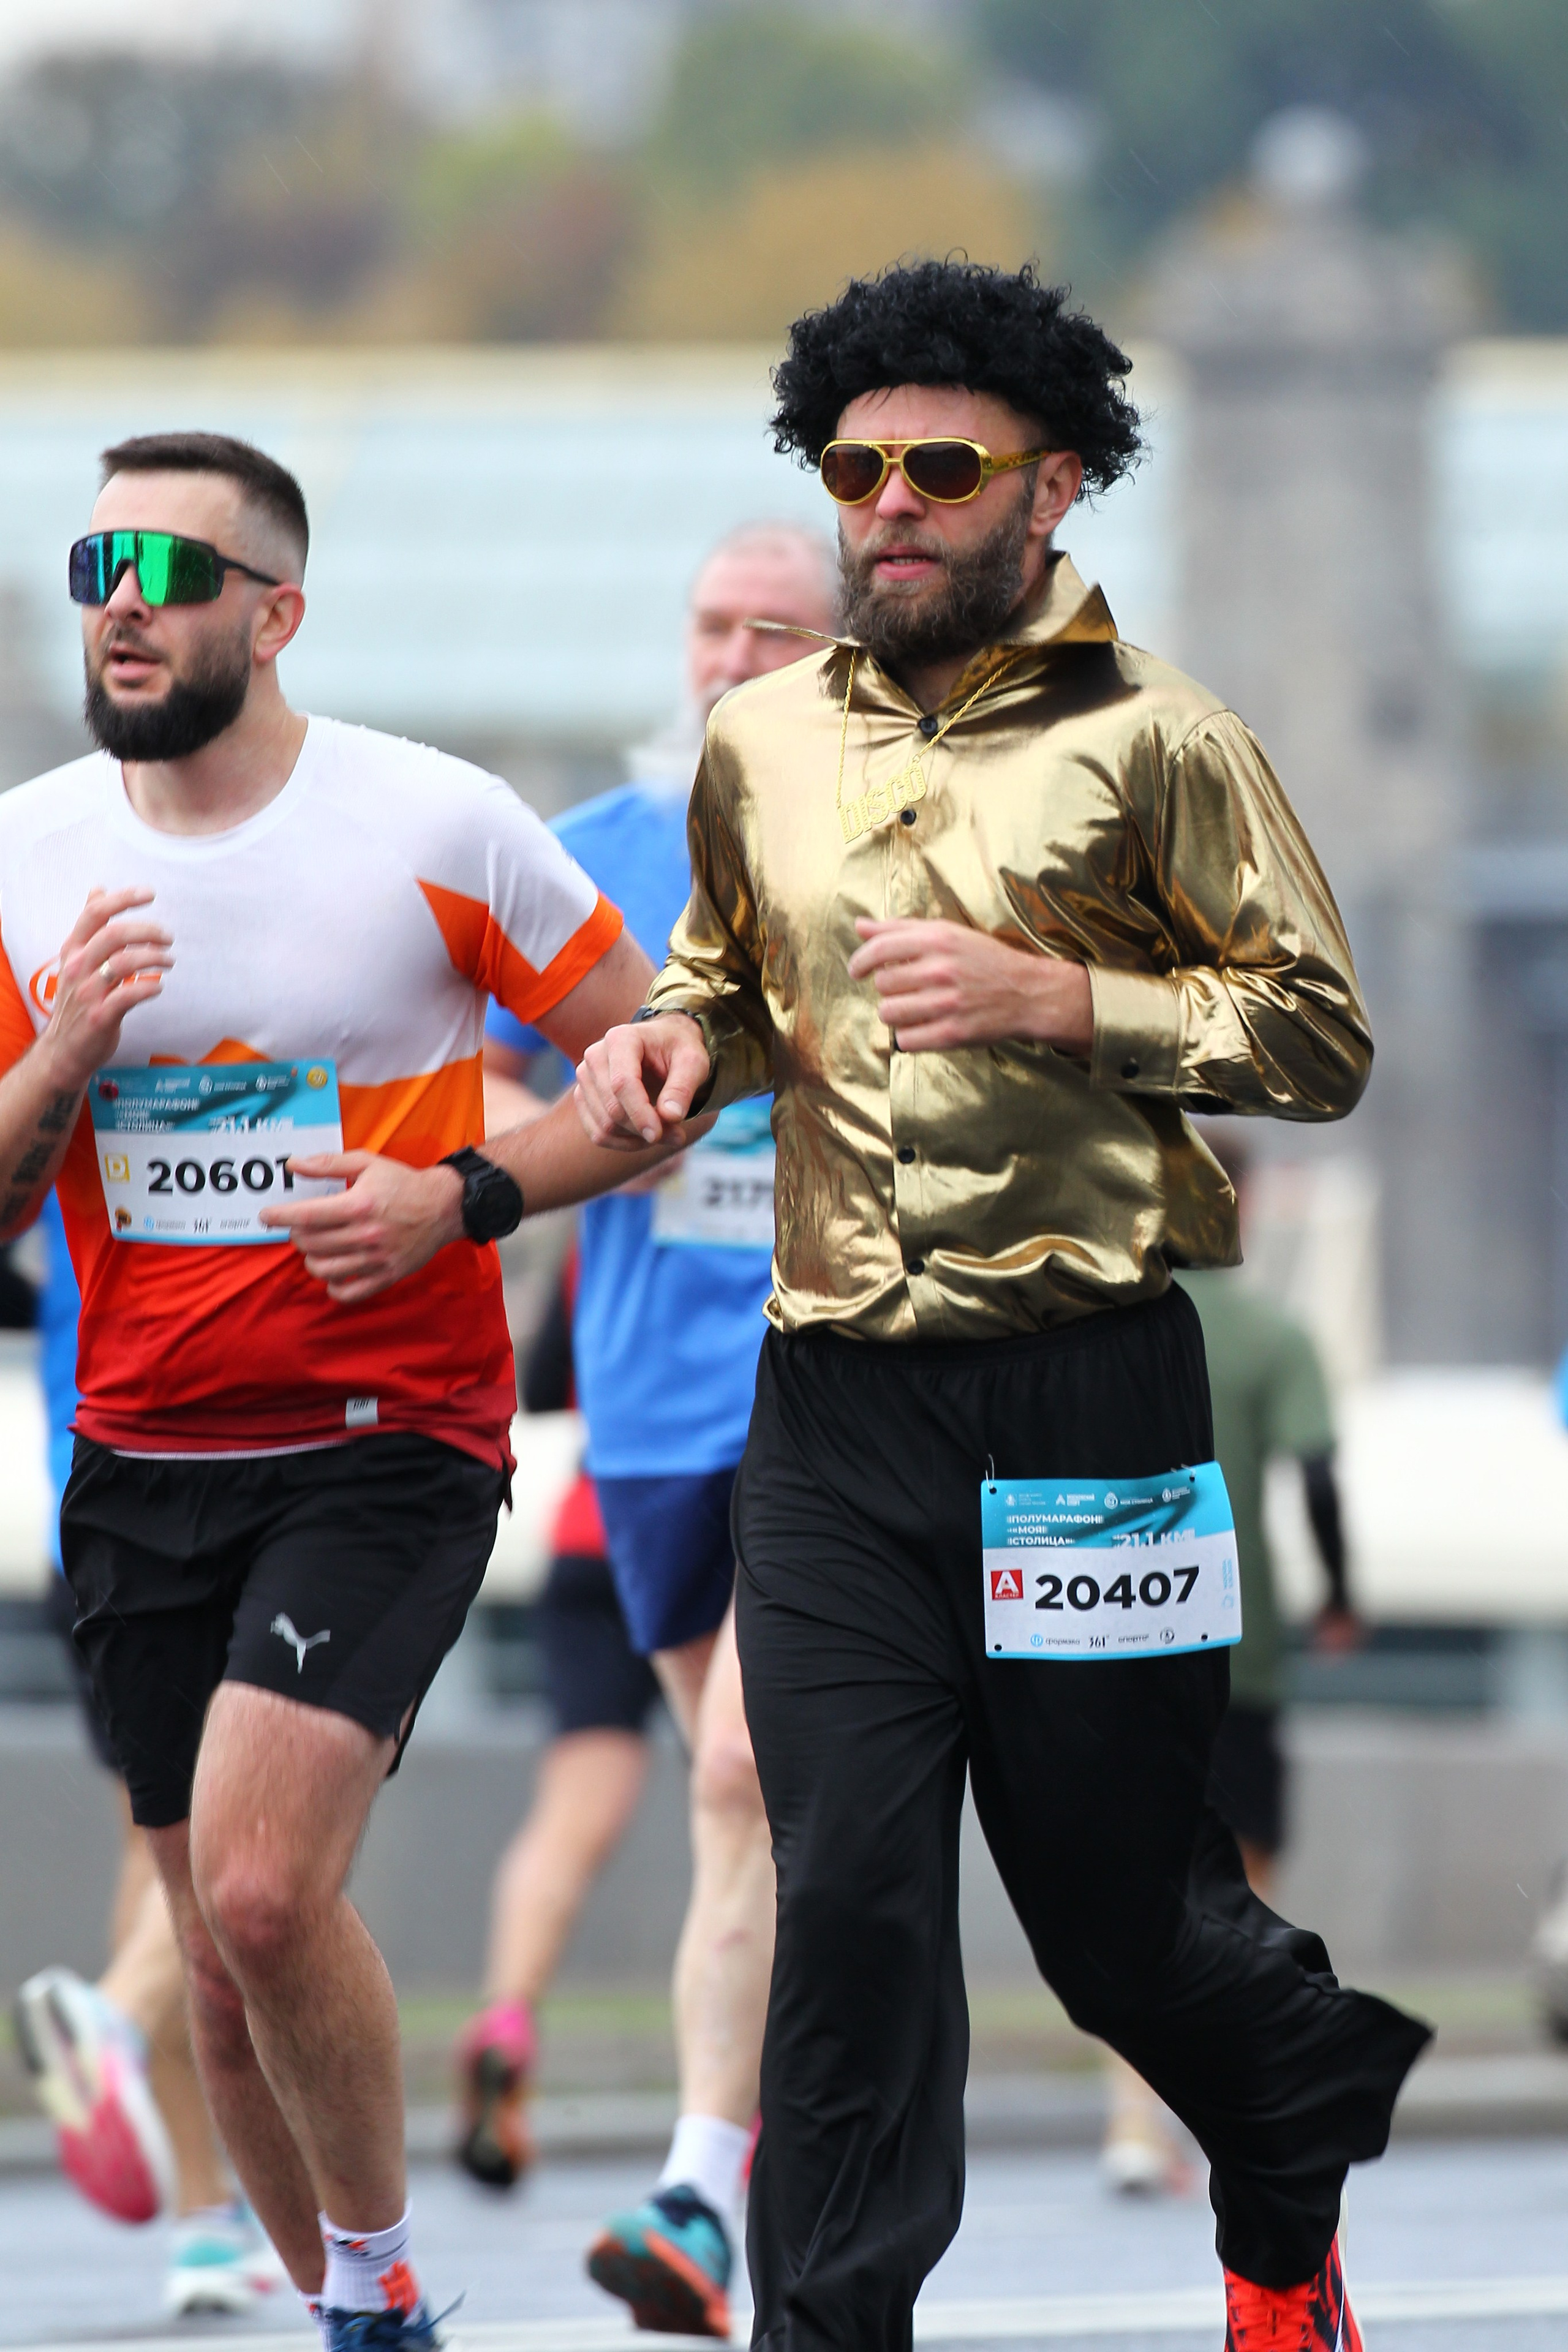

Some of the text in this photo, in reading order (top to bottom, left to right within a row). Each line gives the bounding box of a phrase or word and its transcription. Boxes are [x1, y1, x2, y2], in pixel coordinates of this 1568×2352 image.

[838, 765, 927, 844] DISCO
[147, 1155, 293, 1196] 20601
[1035, 1565, 1199, 1611] 20407
